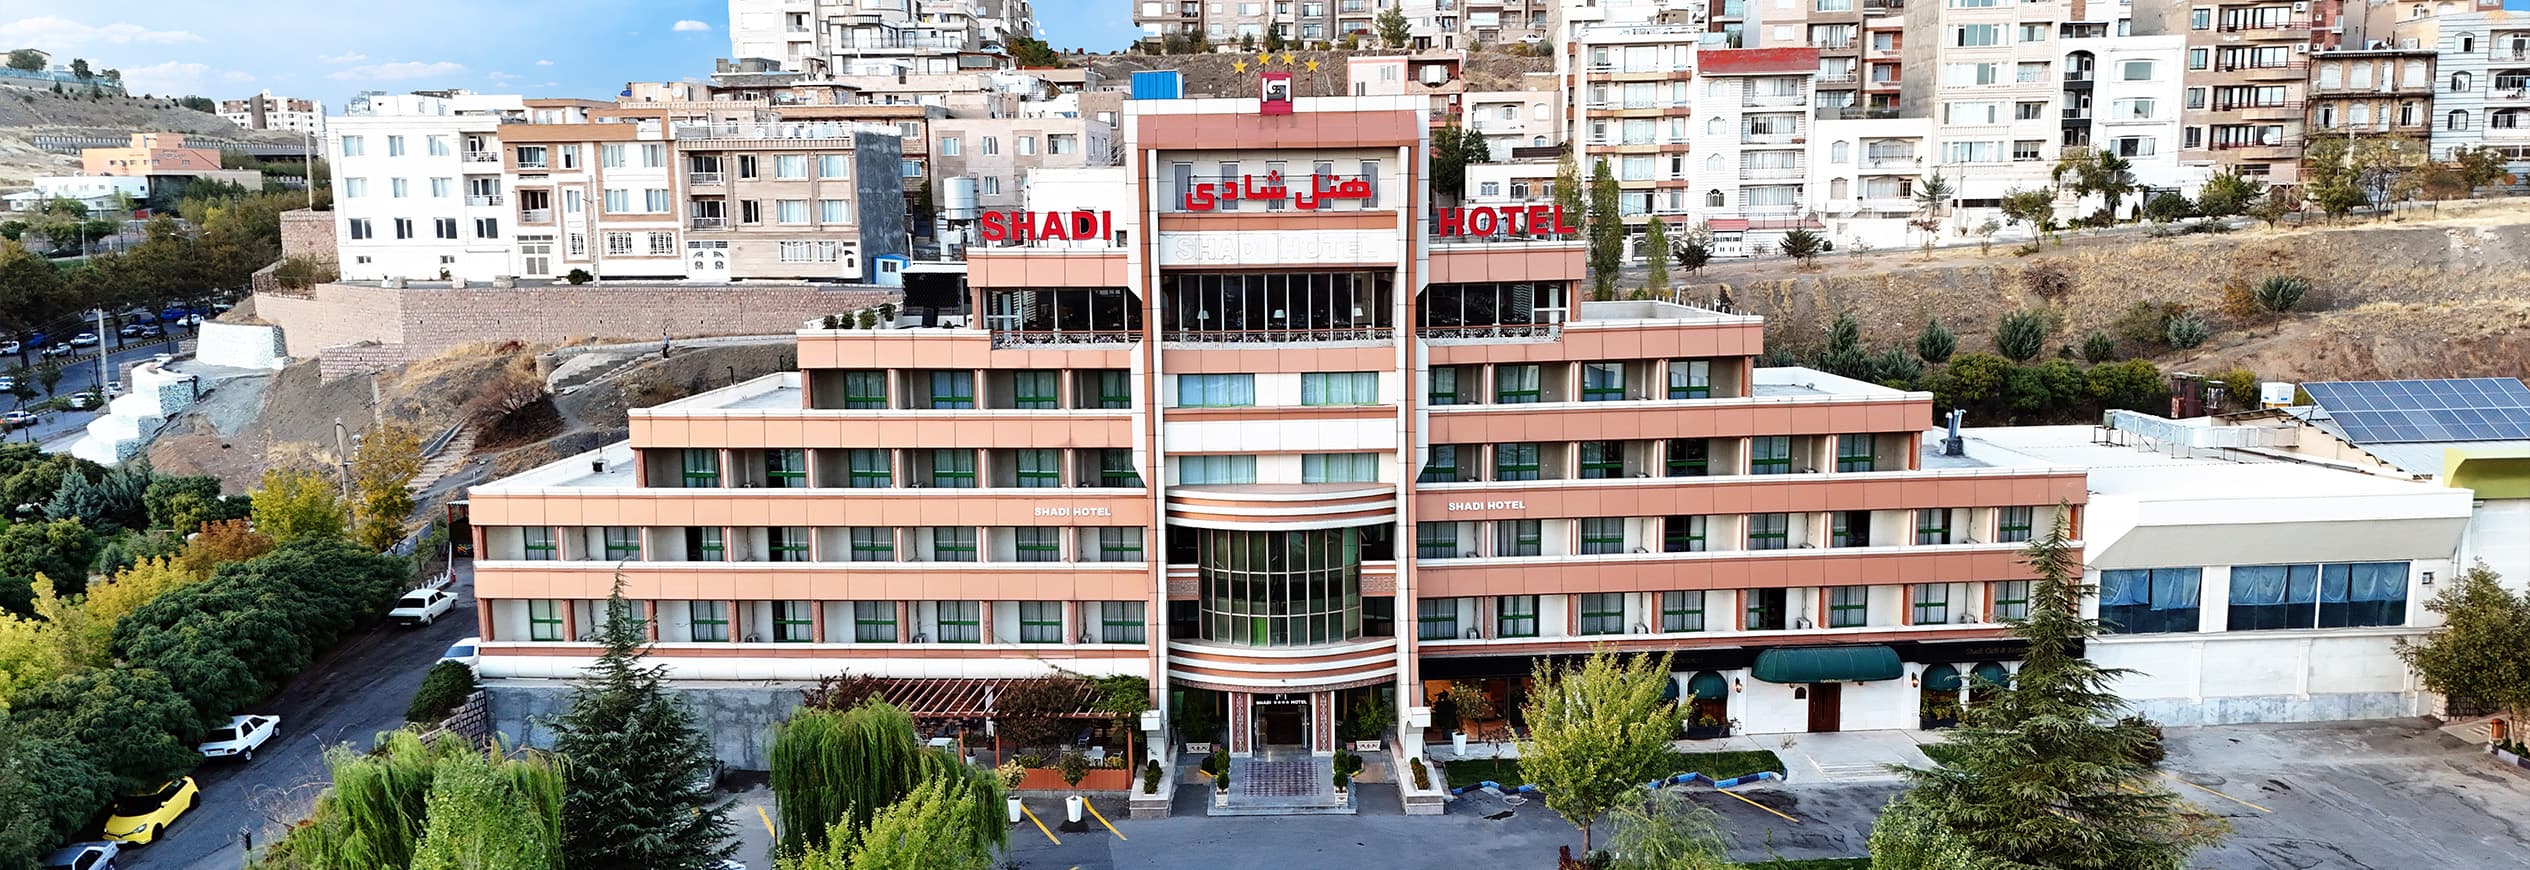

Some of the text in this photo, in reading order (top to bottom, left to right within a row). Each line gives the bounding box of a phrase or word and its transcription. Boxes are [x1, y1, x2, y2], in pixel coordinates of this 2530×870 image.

[1295, 173, 1372, 209] هتل
[981, 204, 1575, 241] SHADI HOTEL
[1175, 235, 1378, 261] SHADI HOTEL
[1034, 507, 1112, 516] SHADI HOTEL
[1448, 500, 1526, 511] SHADI HOTEL
